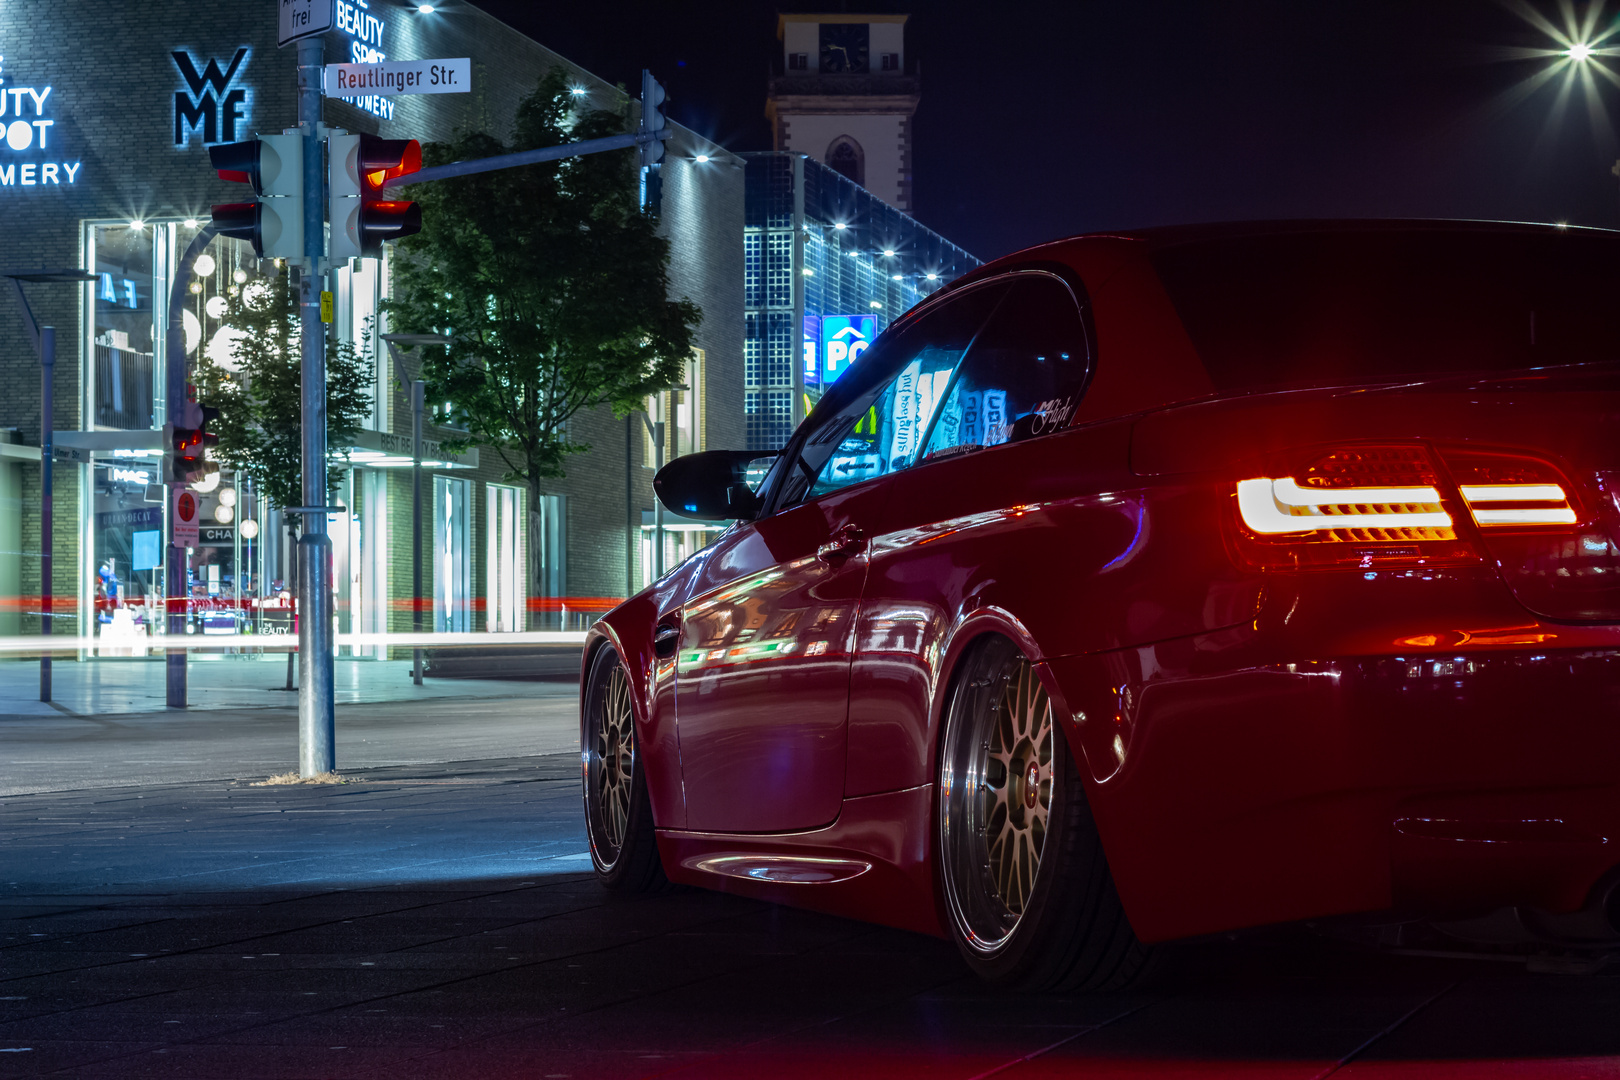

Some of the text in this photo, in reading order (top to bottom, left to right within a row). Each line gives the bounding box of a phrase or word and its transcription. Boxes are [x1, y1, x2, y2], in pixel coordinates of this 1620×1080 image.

[292, 5, 311, 28] frei
[336, 1, 385, 47] BEAUTY
[338, 65, 458, 92] Reutlinger Str.
[170, 48, 249, 144] WMF
[381, 433, 399, 451] BEST
[54, 447, 70, 458] Ulmer
[206, 529, 236, 540] CHA
[259, 627, 289, 635] BEAUTY
